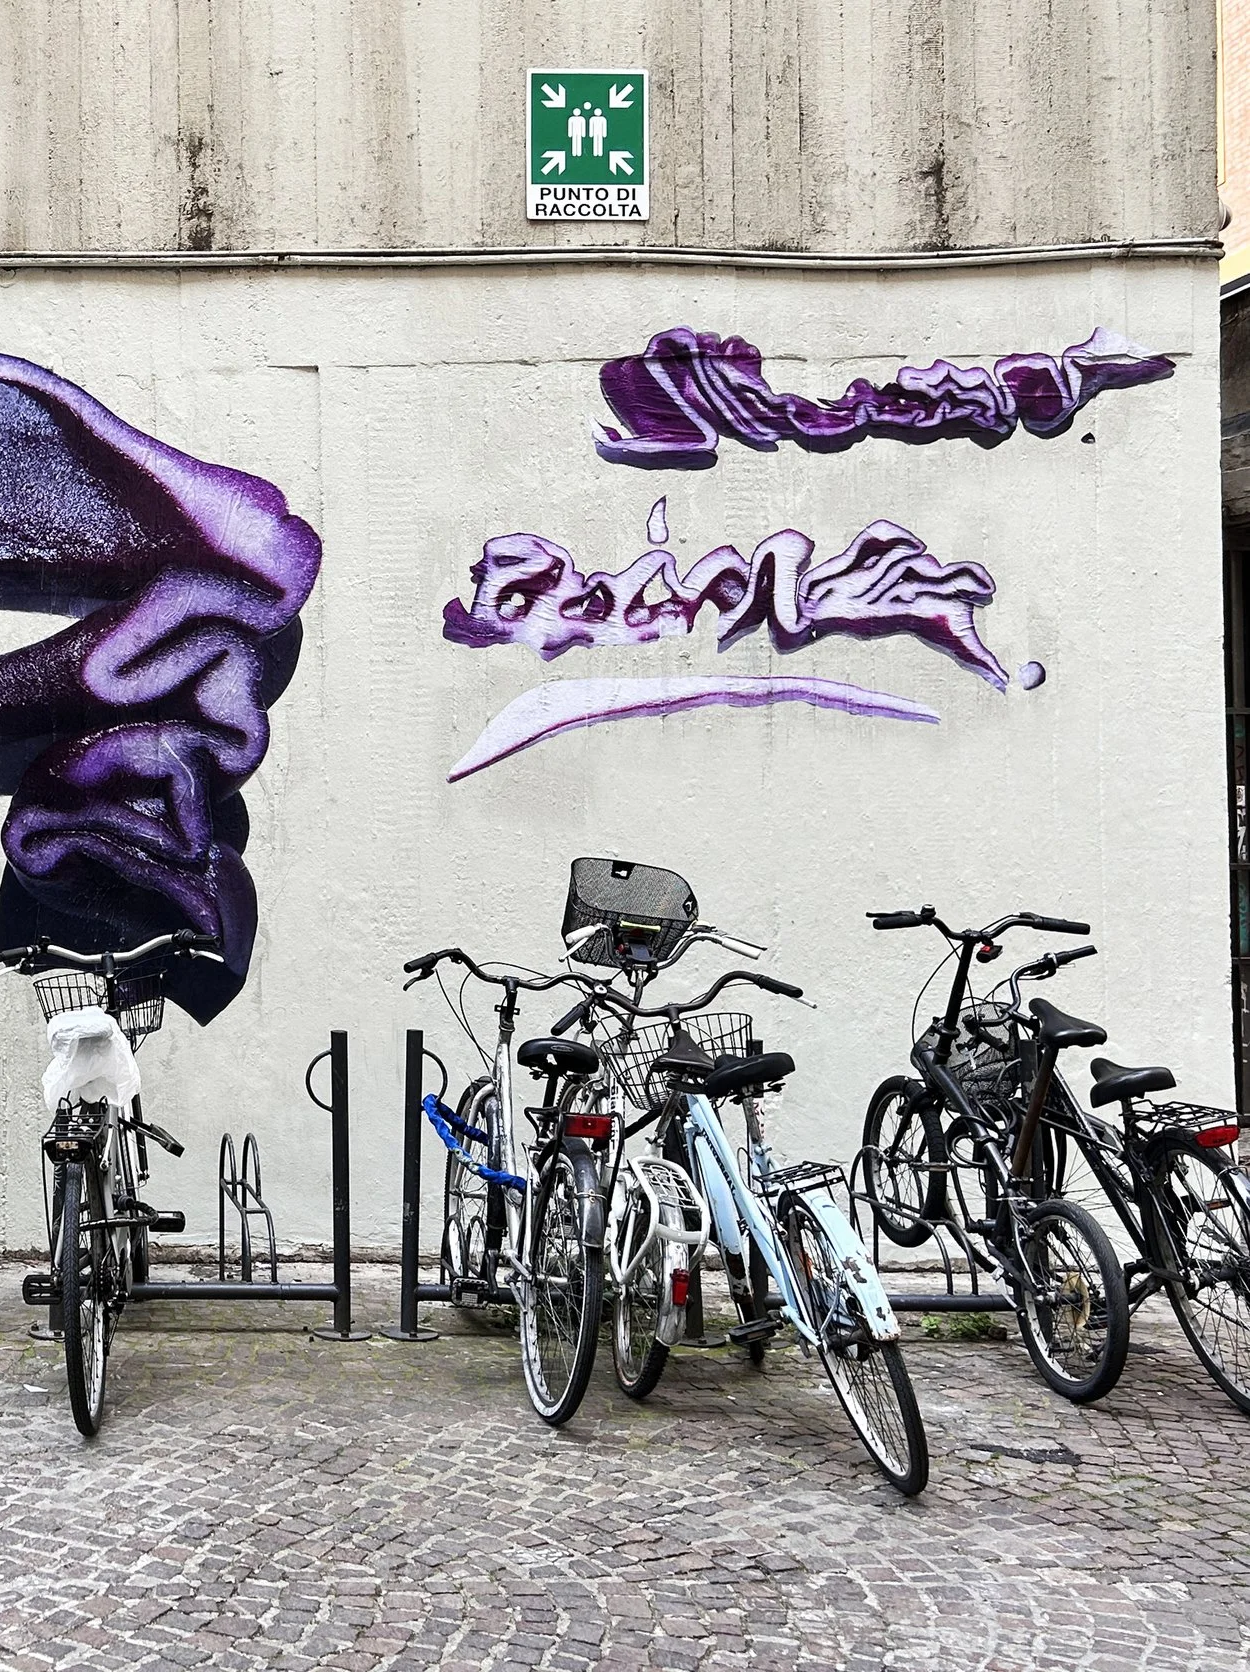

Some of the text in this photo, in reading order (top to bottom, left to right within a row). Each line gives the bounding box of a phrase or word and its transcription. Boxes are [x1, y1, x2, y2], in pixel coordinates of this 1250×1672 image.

[540, 187, 636, 201] PUNTO DI
[535, 203, 642, 217] RACCOLTA
